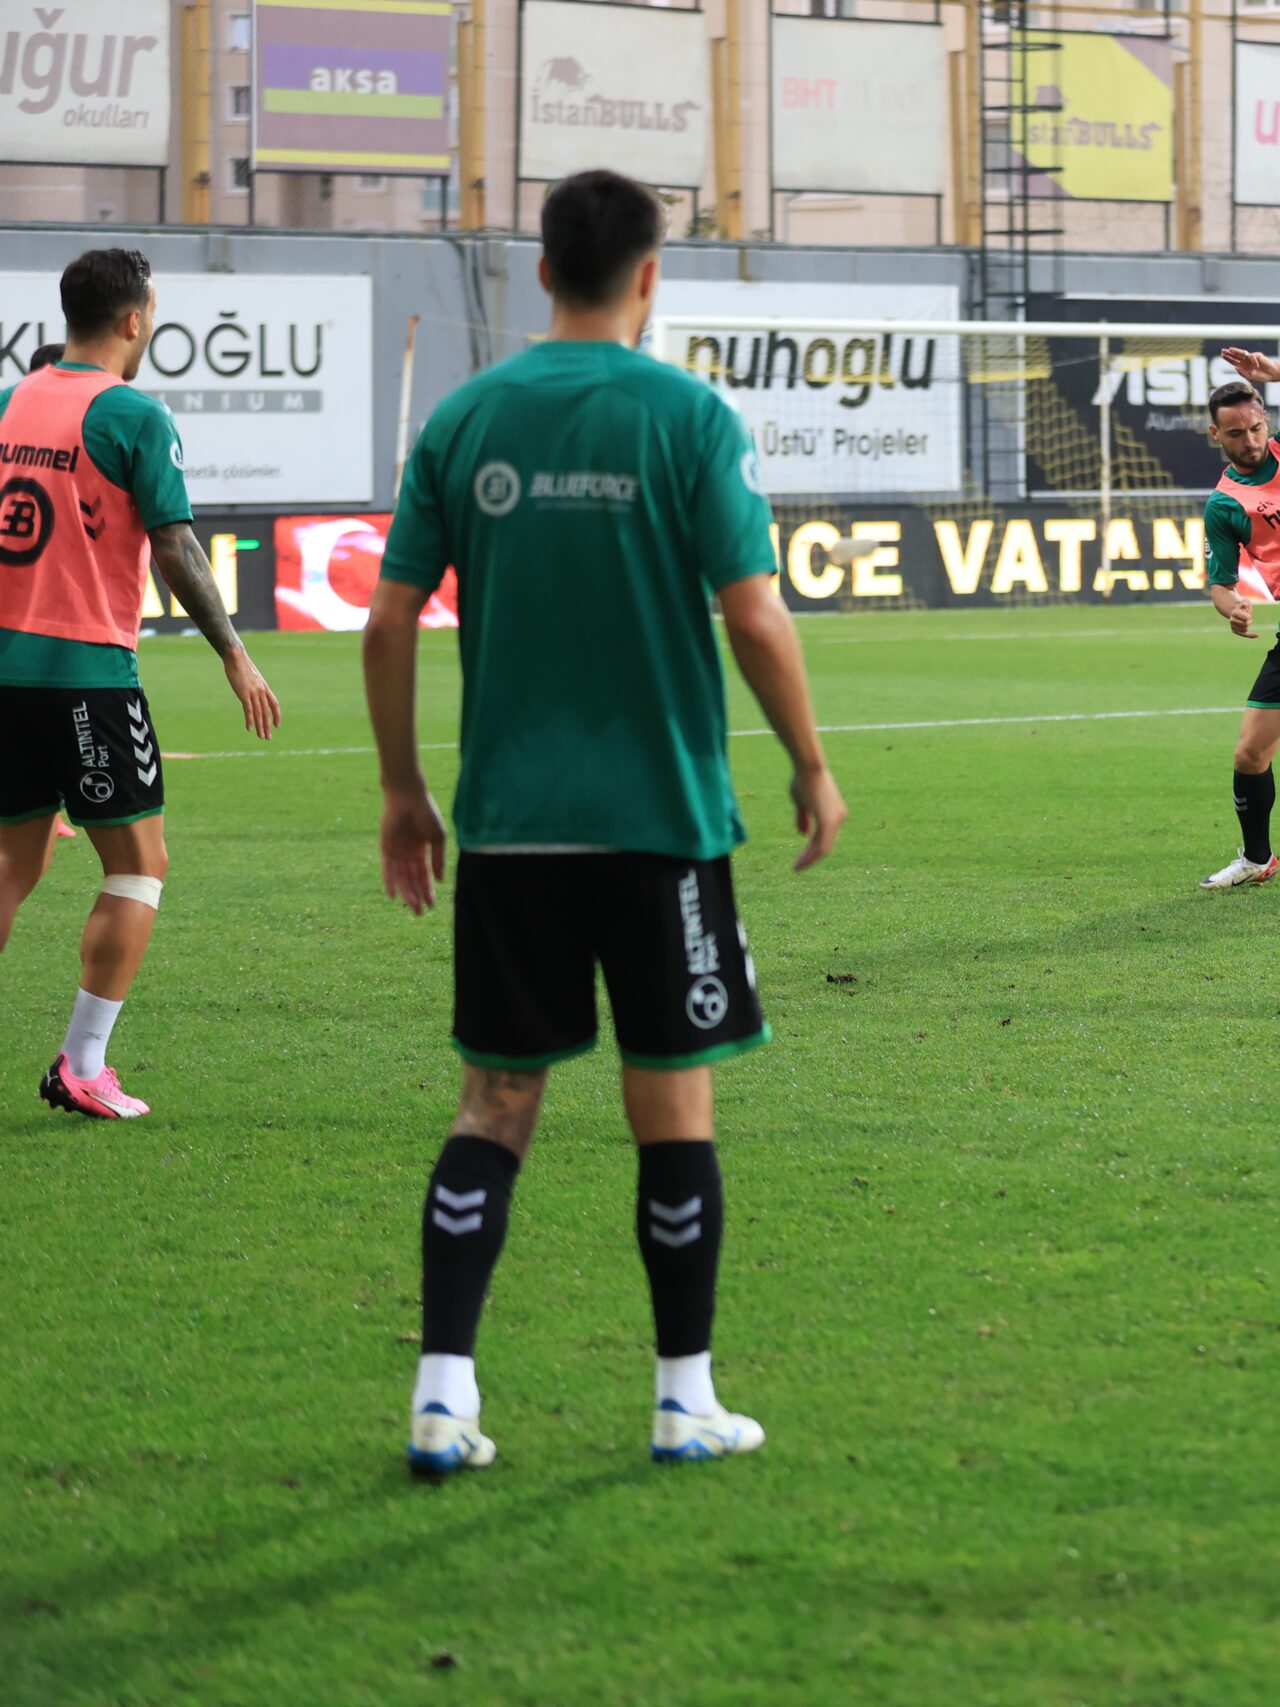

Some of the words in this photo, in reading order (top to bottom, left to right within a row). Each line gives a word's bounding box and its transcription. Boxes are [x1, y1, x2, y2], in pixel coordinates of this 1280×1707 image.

[310, 67, 398, 96] aksa
[782, 77, 838, 110] BHT
[0, 442, 80, 474] ummel
[833, 427, 928, 461] Projeler
[933, 517, 1206, 597] VATAN
